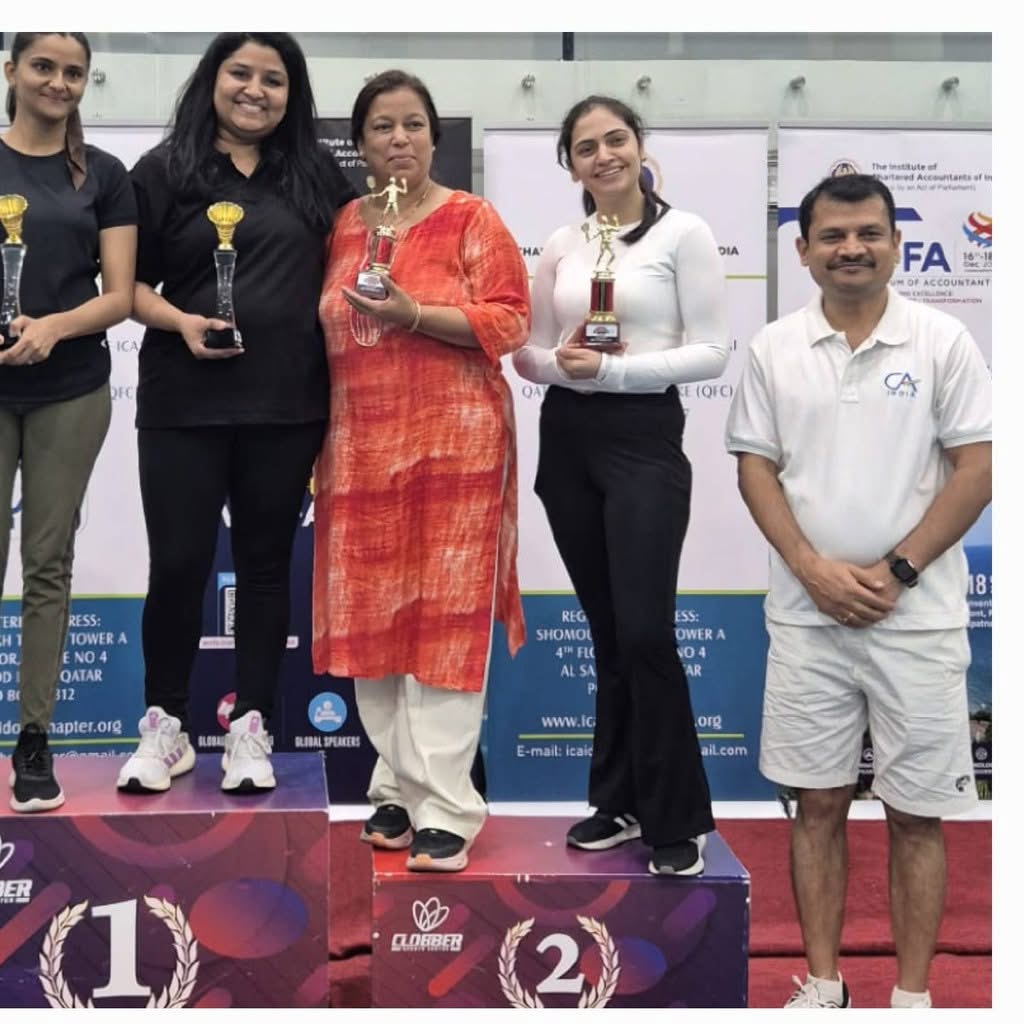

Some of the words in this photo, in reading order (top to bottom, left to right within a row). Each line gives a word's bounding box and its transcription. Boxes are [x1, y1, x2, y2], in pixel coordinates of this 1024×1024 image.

[916, 174, 972, 182] Accountants
[903, 242, 951, 272] FA
[69, 615, 102, 627] RESS:
[71, 632, 114, 645] TOWER
[118, 632, 128, 644] A
[716, 628, 726, 640] A
[74, 652, 96, 664] NO
[99, 651, 108, 663] 4
[698, 647, 706, 658] 4
[60, 670, 102, 682] QATAR
[560, 665, 575, 677] AL
[295, 736, 322, 748] GLOBAL
[324, 736, 360, 748] SPEAKERS
[517, 745, 562, 758] E-mail:
[391, 934, 463, 948] CLOBBER
[91, 899, 151, 999] 1
[536, 933, 585, 994] 2
